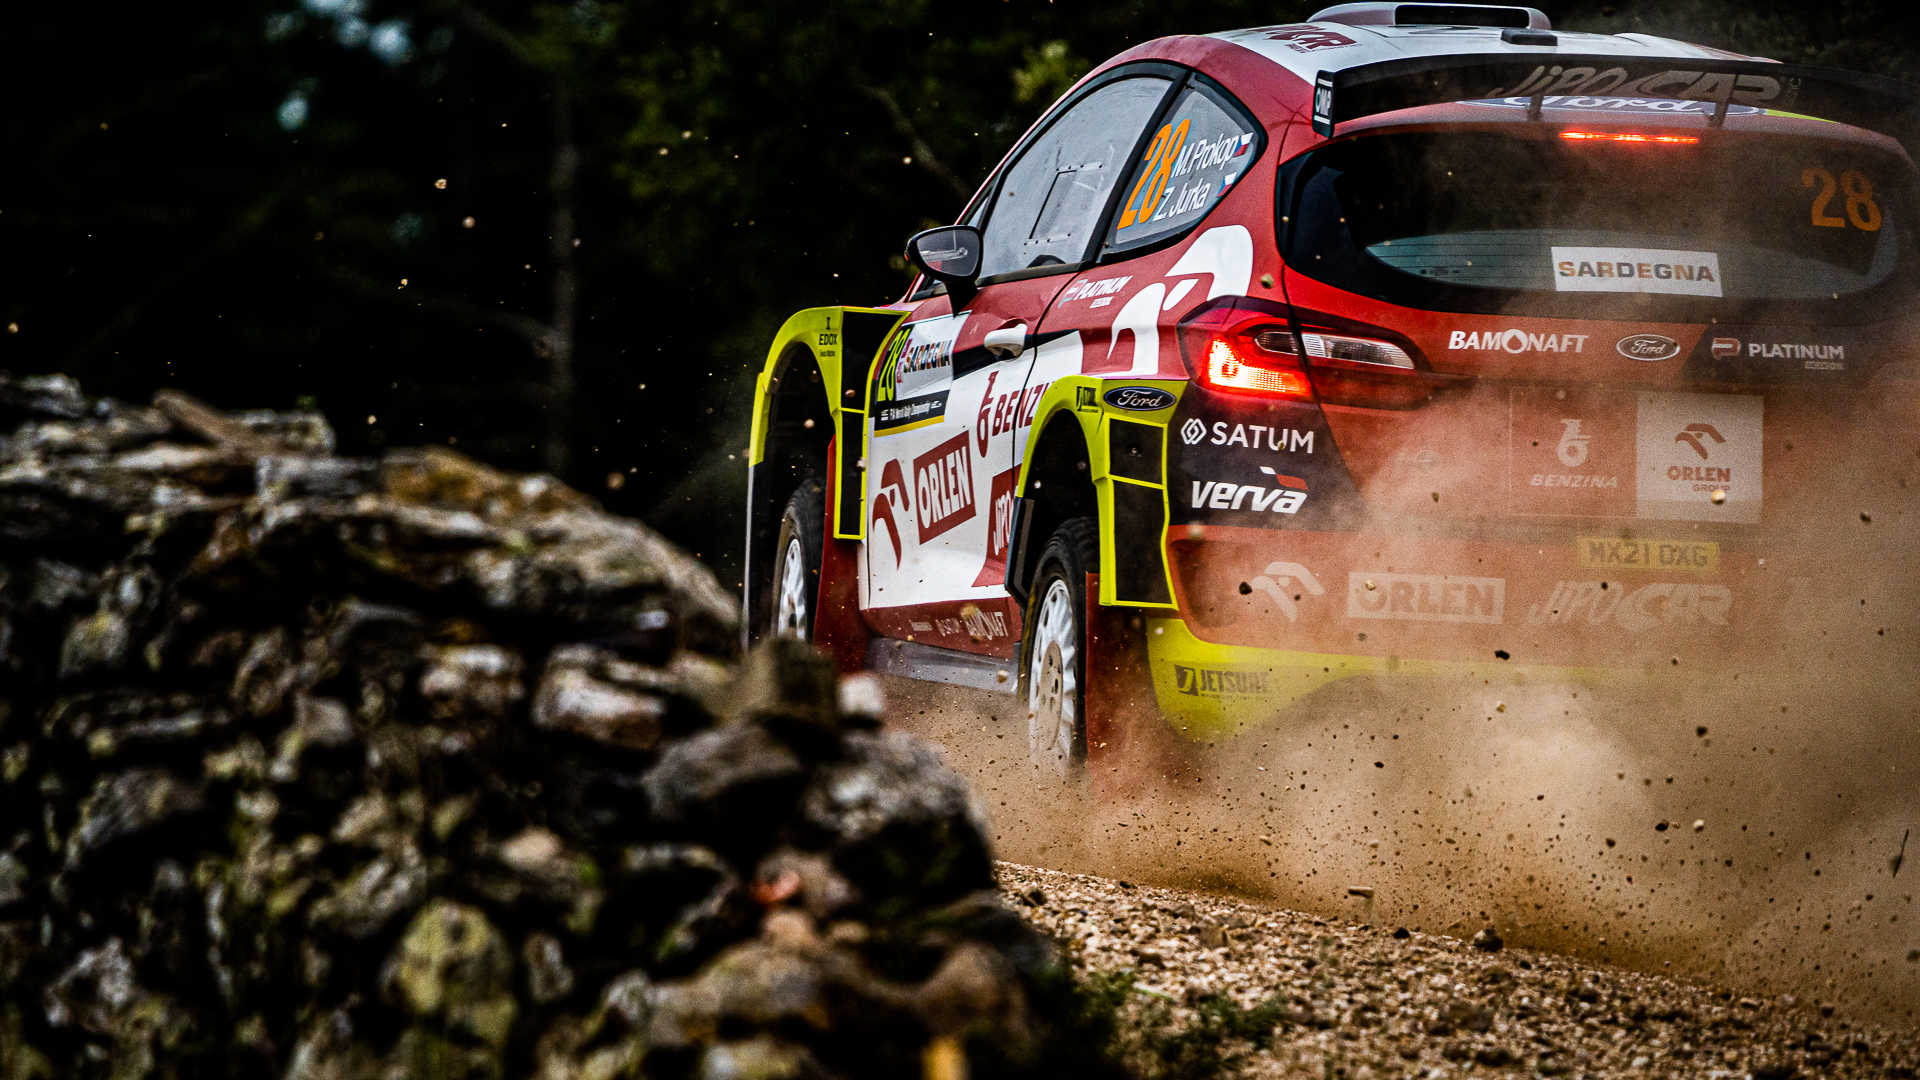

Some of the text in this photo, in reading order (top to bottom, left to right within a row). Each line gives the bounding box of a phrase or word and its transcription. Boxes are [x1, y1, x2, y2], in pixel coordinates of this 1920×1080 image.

[1117, 119, 1191, 230] 28
[1801, 168, 1882, 231] 28
[1558, 261, 1715, 282] SARDEGNA
[819, 333, 838, 346] EDOX
[1448, 328, 1589, 354] BAMONAFT
[1631, 339, 1666, 355] Ford
[1749, 342, 1844, 360] PLATINUM
[877, 328, 911, 402] 28
[903, 339, 953, 374] SARDEGNA
[1117, 389, 1163, 407] Ford
[1211, 421, 1315, 454] SATUM
[1530, 473, 1619, 489] BENZINA
[1667, 465, 1731, 483] ORLEN
[918, 446, 972, 529] ORLEN
[1693, 483, 1732, 493] GROUP
[1359, 580, 1496, 616] ORLEN
